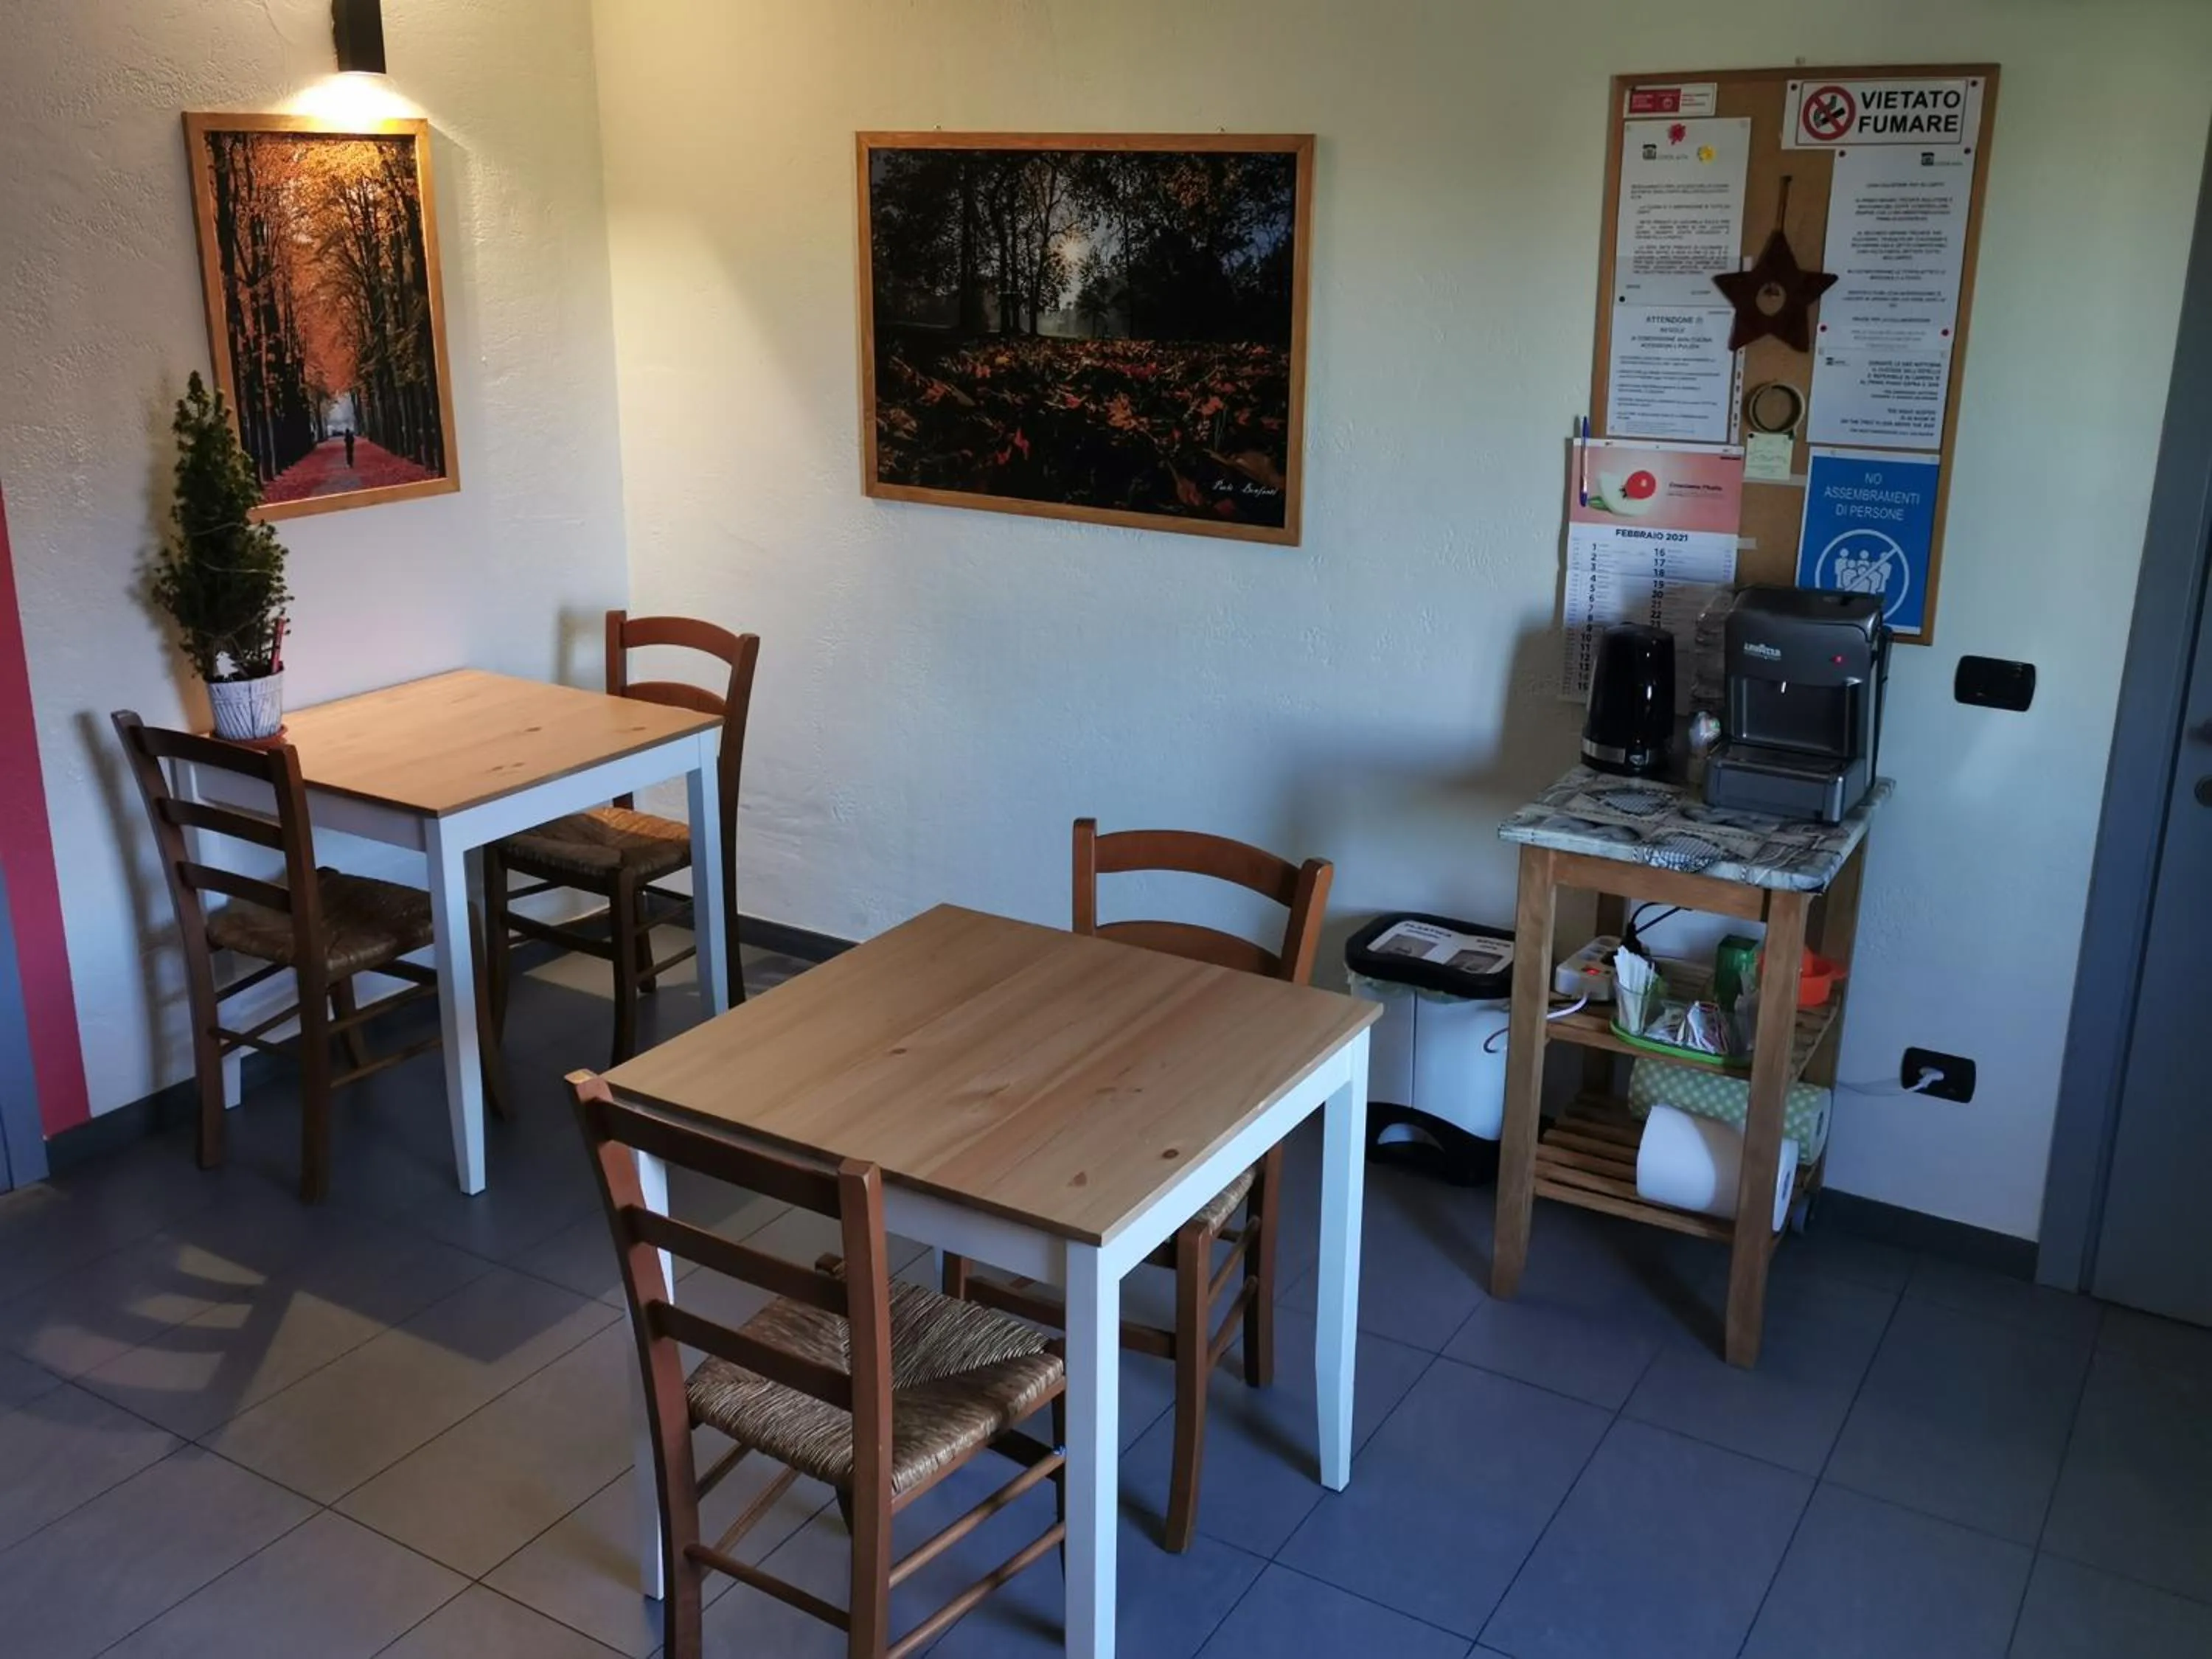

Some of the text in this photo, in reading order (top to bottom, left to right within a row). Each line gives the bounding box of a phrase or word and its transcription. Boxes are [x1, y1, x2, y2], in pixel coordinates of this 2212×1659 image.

[1861, 90, 1961, 109] VIETATO
[1858, 114, 1958, 133] FUMARE
[1865, 473, 1882, 484] NO
[1824, 487, 1920, 505] ASSEMBRAMENTI
[1836, 504, 1904, 521] DI PERSONE
[1615, 528, 1688, 542] FEBBRAIO 2021
[1591, 543, 1596, 551] 1
[1654, 548, 1665, 557] 16
[1654, 558, 1665, 566] 17
[1654, 568, 1665, 577] 18
[1653, 580, 1664, 588] 19
[1589, 594, 1595, 602] 6
[1652, 591, 1663, 599] 20
[1651, 611, 1662, 619] 22
[1581, 633, 1592, 642] 10
